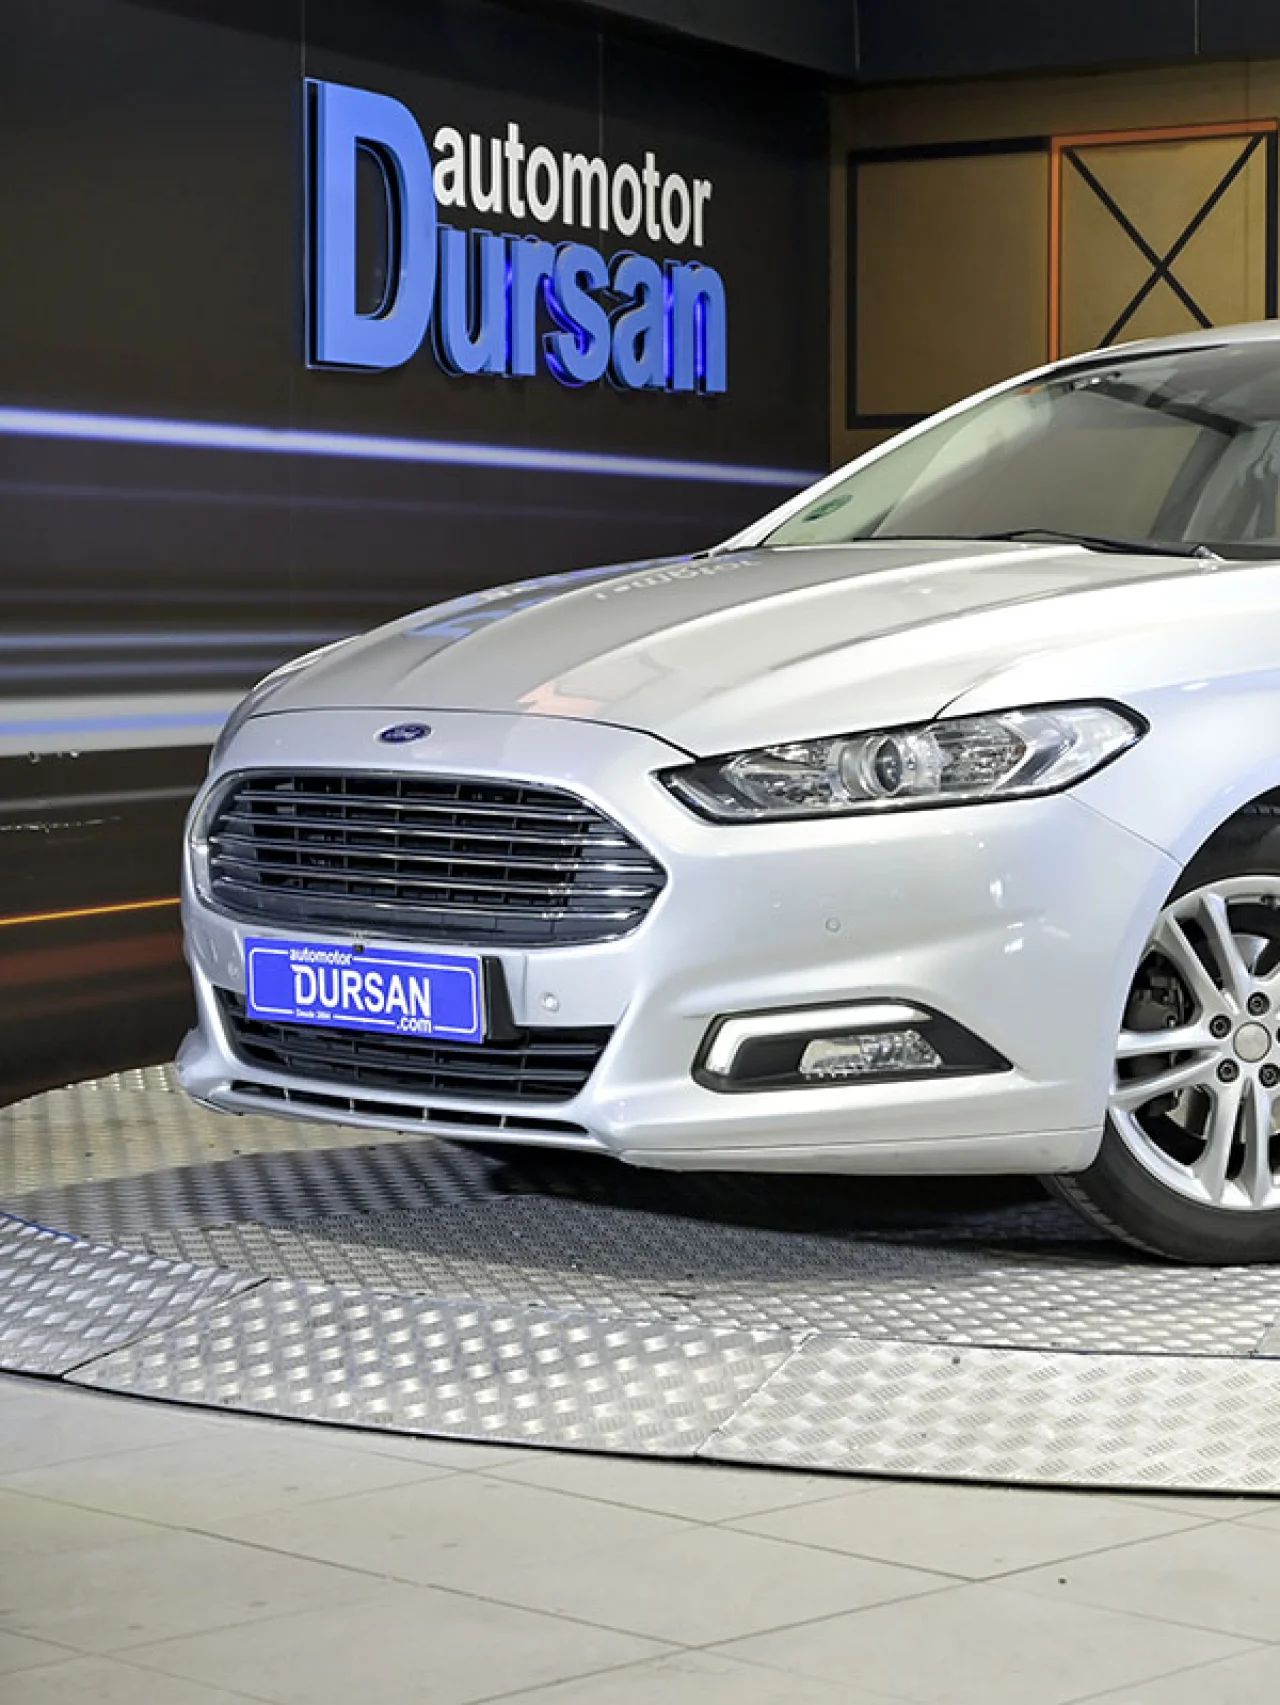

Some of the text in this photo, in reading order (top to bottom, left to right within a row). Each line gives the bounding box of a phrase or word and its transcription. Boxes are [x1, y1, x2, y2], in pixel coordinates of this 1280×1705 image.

[304, 76, 727, 393] Dursan
[433, 122, 711, 246] automotor
[290, 963, 431, 1017] DURSAN
